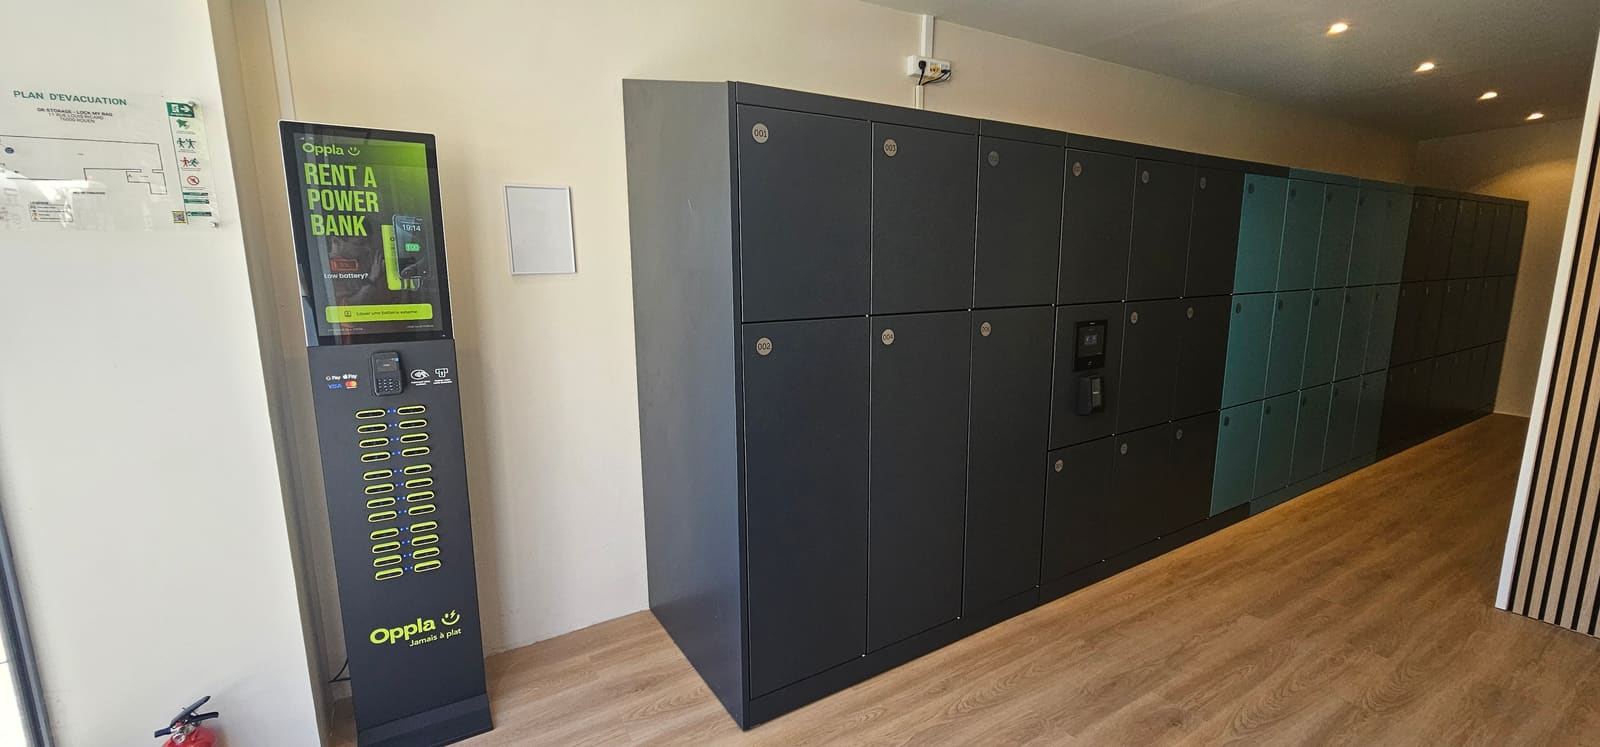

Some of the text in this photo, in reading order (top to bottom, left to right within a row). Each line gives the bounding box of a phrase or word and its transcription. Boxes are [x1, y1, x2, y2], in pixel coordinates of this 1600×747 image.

[13, 90, 127, 106] PLAN D'EVACUATION
[302, 142, 344, 156] Oppla
[303, 162, 378, 188] RENT A
[307, 188, 380, 213] POWER
[310, 213, 368, 237] BANK
[338, 272, 369, 280] battery?
[369, 617, 436, 645] Oppla
[409, 628, 462, 647] Jamais à plat
